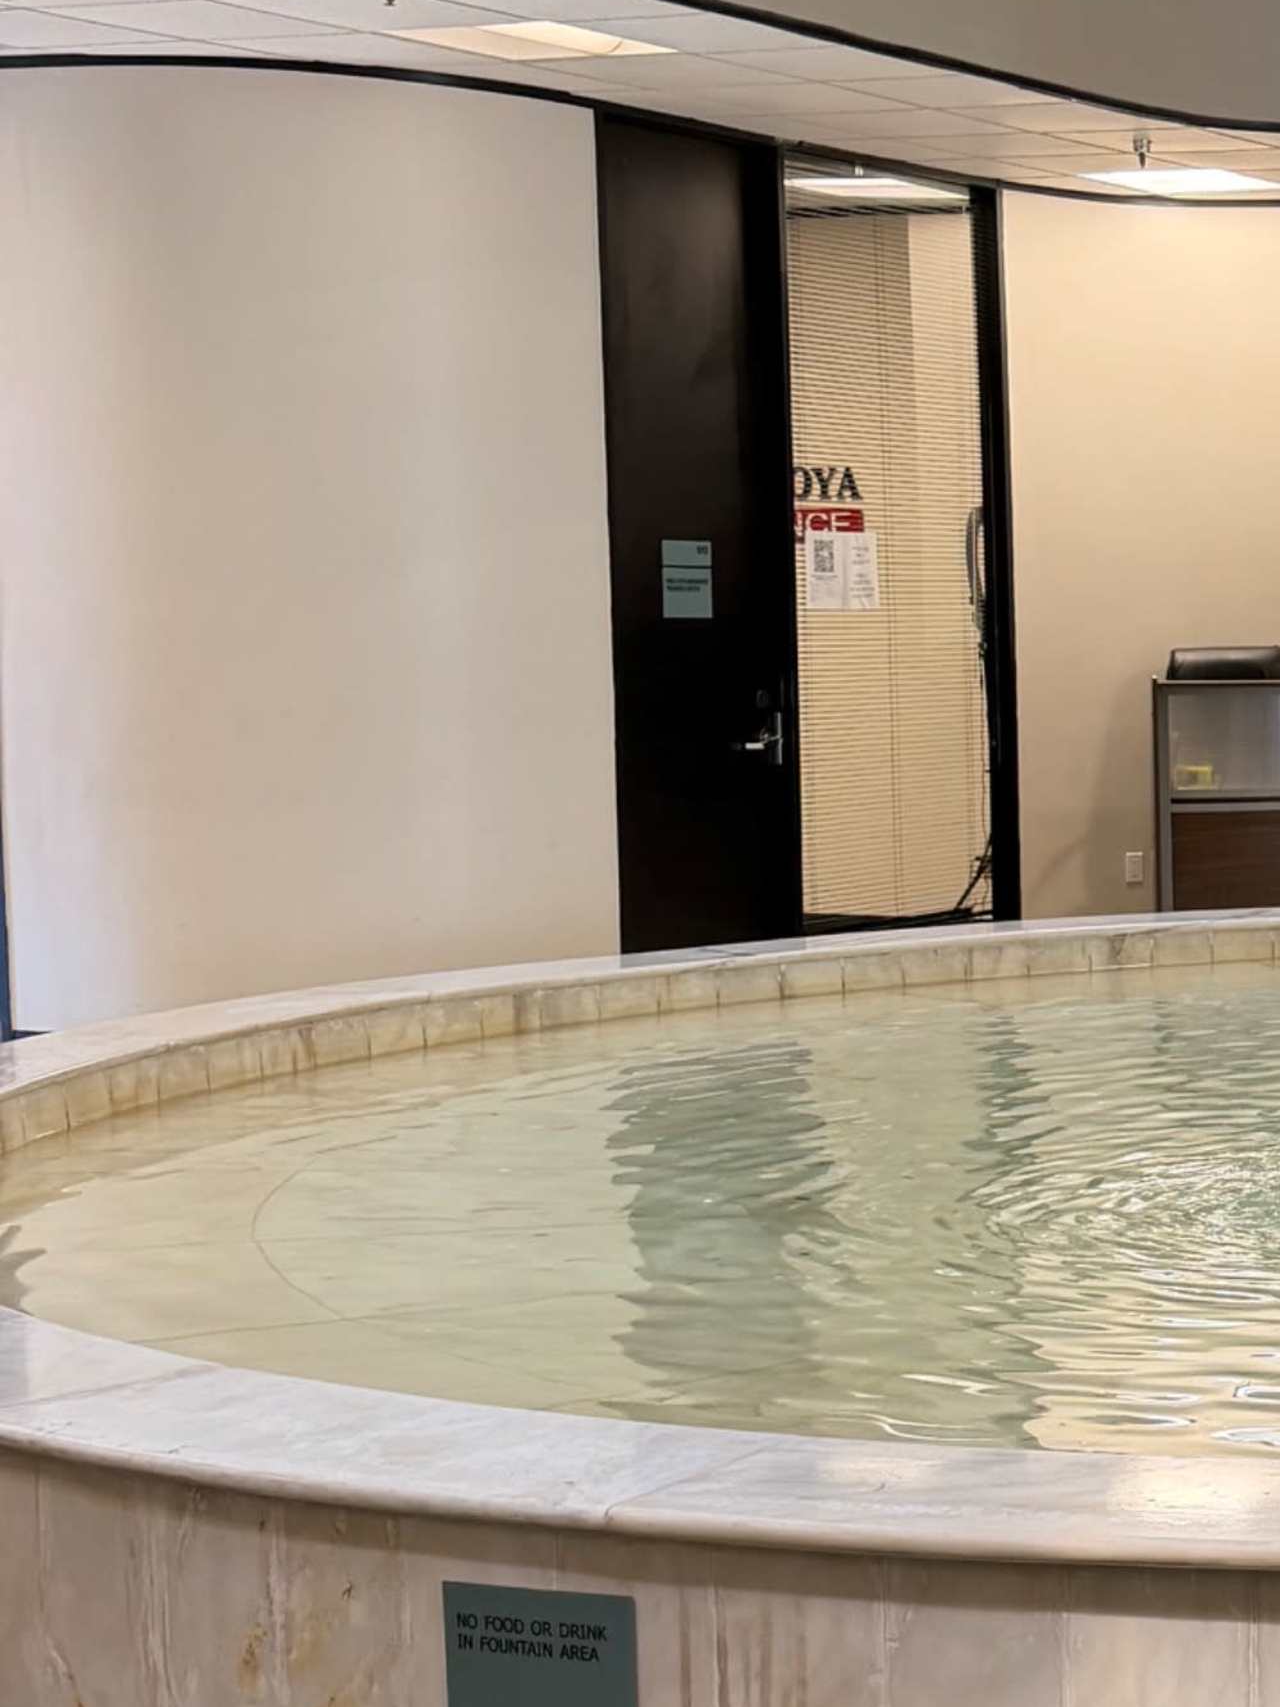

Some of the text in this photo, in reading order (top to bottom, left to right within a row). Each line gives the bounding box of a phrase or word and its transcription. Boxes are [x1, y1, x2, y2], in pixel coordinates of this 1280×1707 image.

[456, 1612, 608, 1642] NO FOOD OR DRINK
[457, 1633, 599, 1662] IN FOUNTAIN AREA
